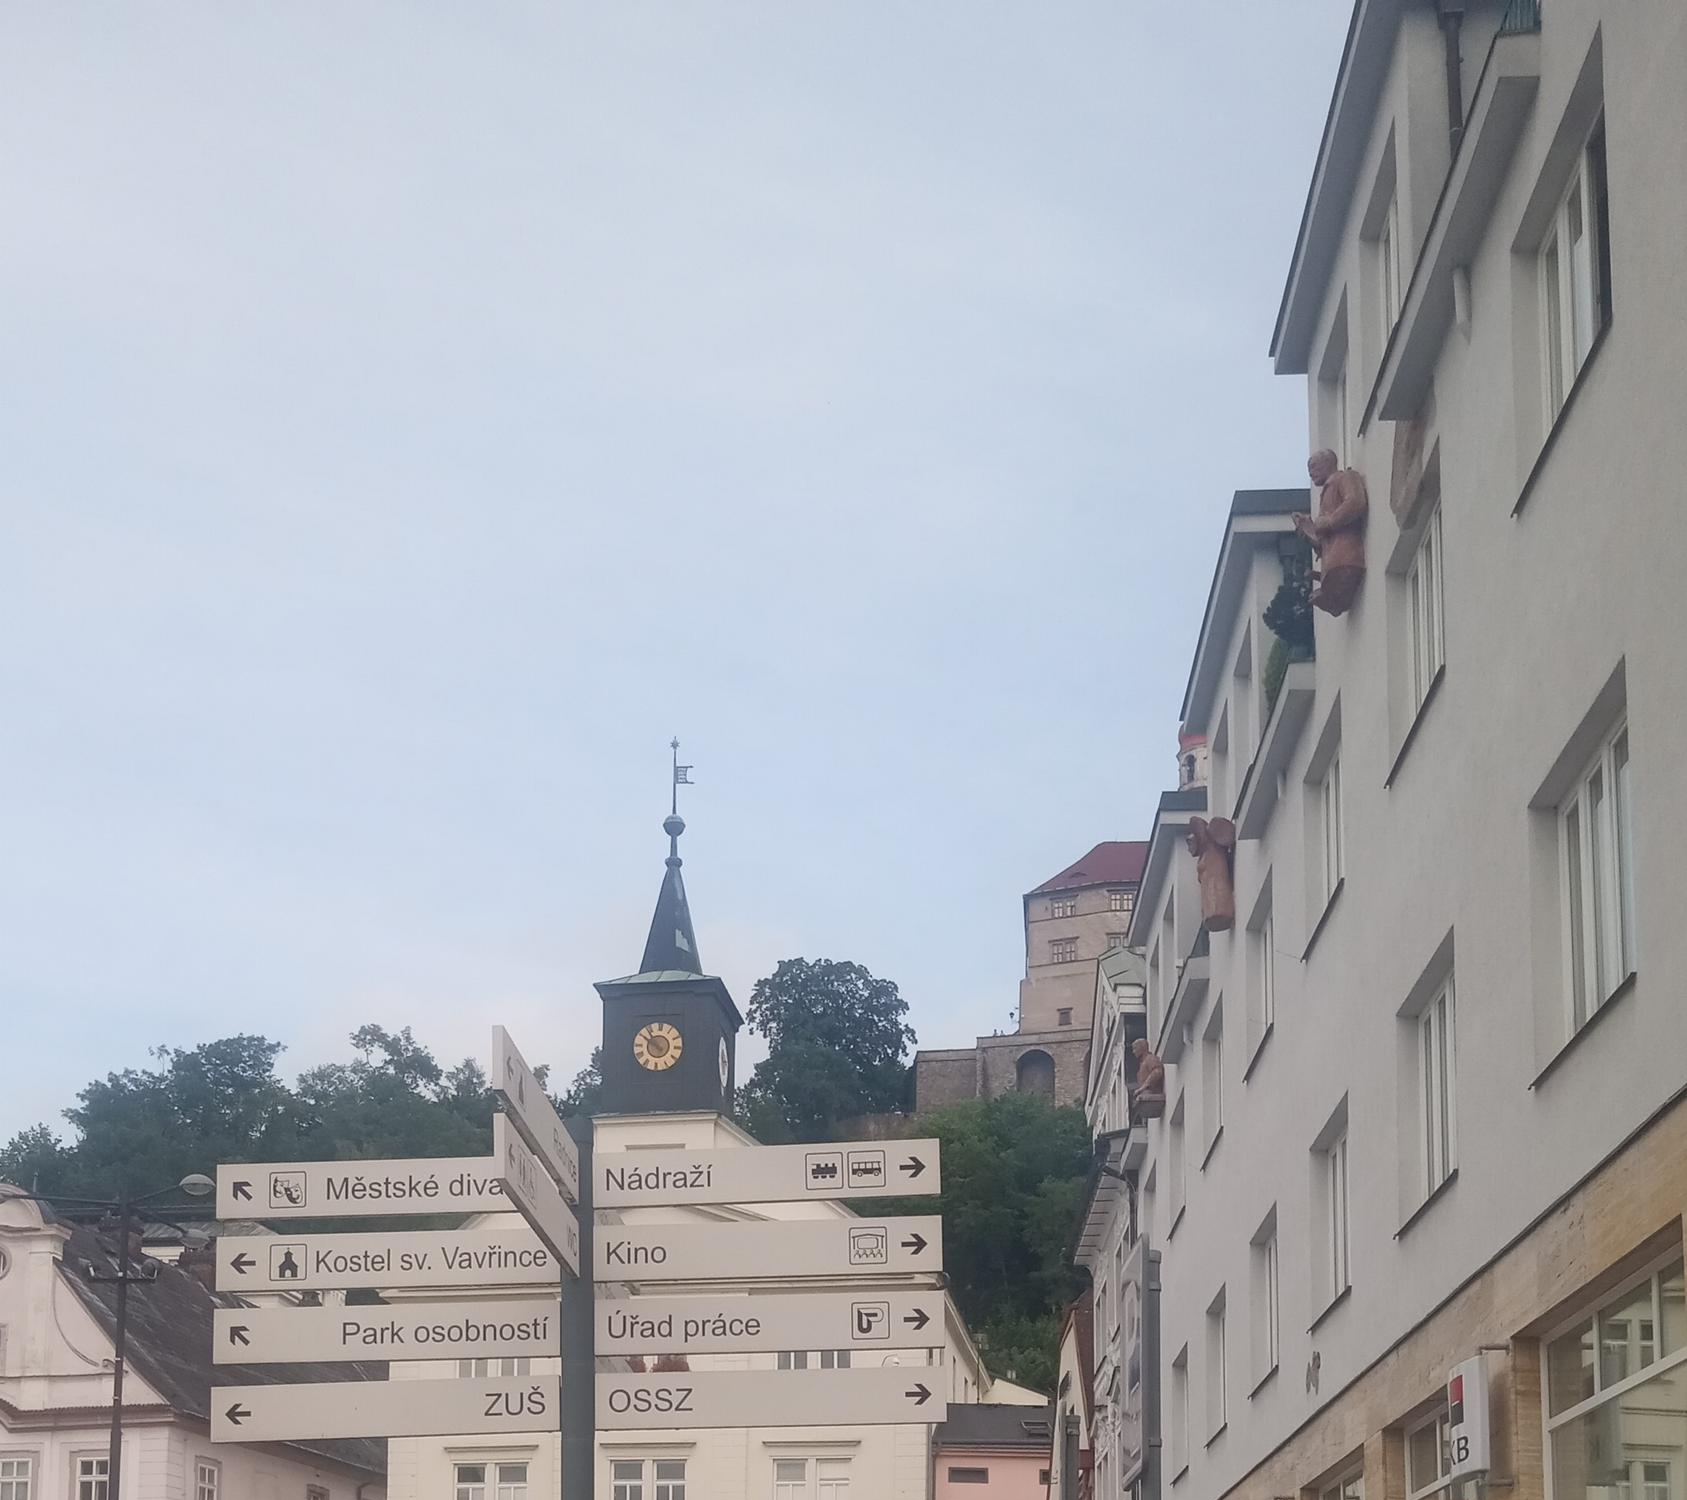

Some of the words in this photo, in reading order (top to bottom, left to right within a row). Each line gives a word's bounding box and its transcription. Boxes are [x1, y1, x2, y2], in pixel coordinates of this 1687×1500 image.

[326, 1175, 439, 1201] Městské
[605, 1164, 713, 1192] Nádraží
[315, 1248, 391, 1274] Kostel
[400, 1253, 432, 1272] sv.
[440, 1245, 548, 1271] Vavřince
[606, 1241, 667, 1265] Kino
[342, 1320, 405, 1346] Park
[414, 1316, 550, 1344] osobností
[607, 1309, 673, 1339] Úřad
[684, 1312, 761, 1343] práce
[484, 1386, 546, 1417] ZUŠ
[608, 1387, 694, 1413] OSSZ
